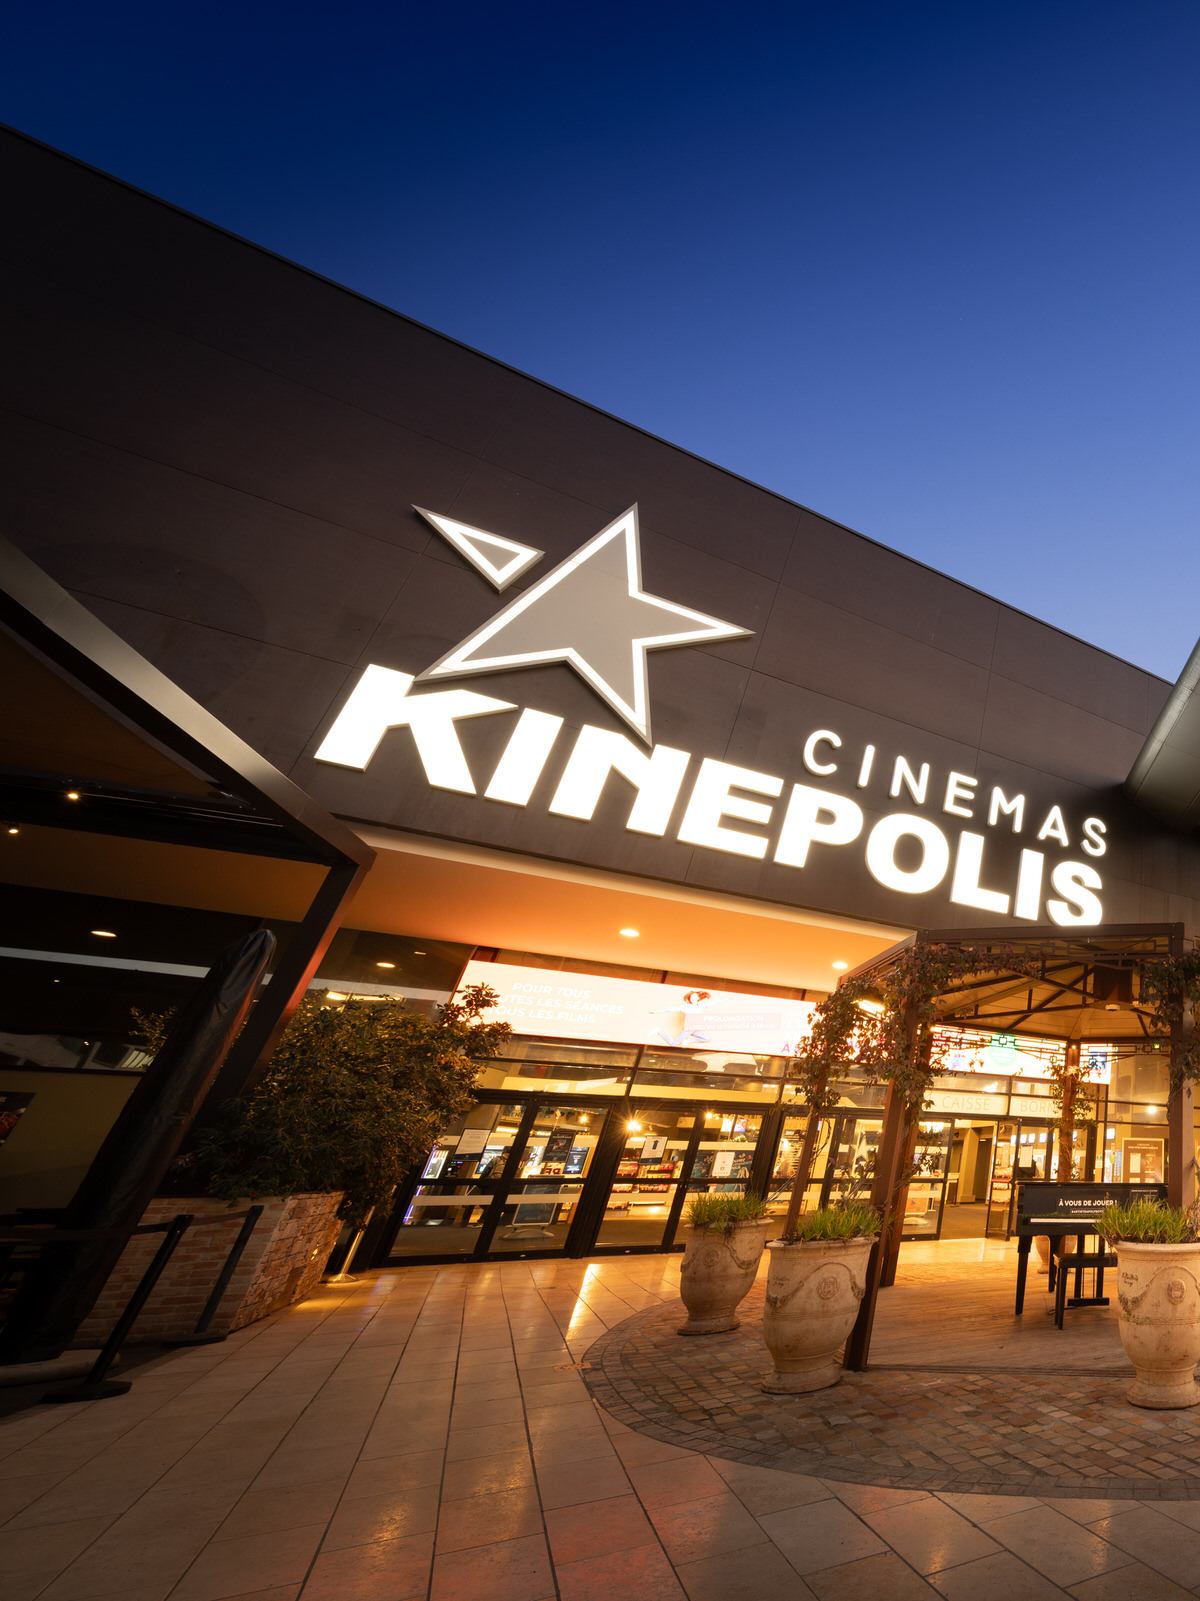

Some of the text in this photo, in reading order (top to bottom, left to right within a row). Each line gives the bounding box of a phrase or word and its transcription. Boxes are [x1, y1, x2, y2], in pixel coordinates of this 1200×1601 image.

[313, 663, 1104, 927] KINEPOLIS
[802, 728, 1107, 857] CINEMAS
[512, 982, 592, 999] POUR TOUS
[498, 992, 625, 1015] UTES LES SÉANCES
[489, 1004, 598, 1024] TOUS LES FILMS
[703, 1014, 764, 1023] PROLONGATION
[942, 1095, 1060, 1114] CAISSE BORN
[1058, 1198, 1064, 1207] À
[1064, 1199, 1082, 1207] VOUS
[1083, 1199, 1092, 1207] DE
[1092, 1199, 1114, 1207] JOUER
